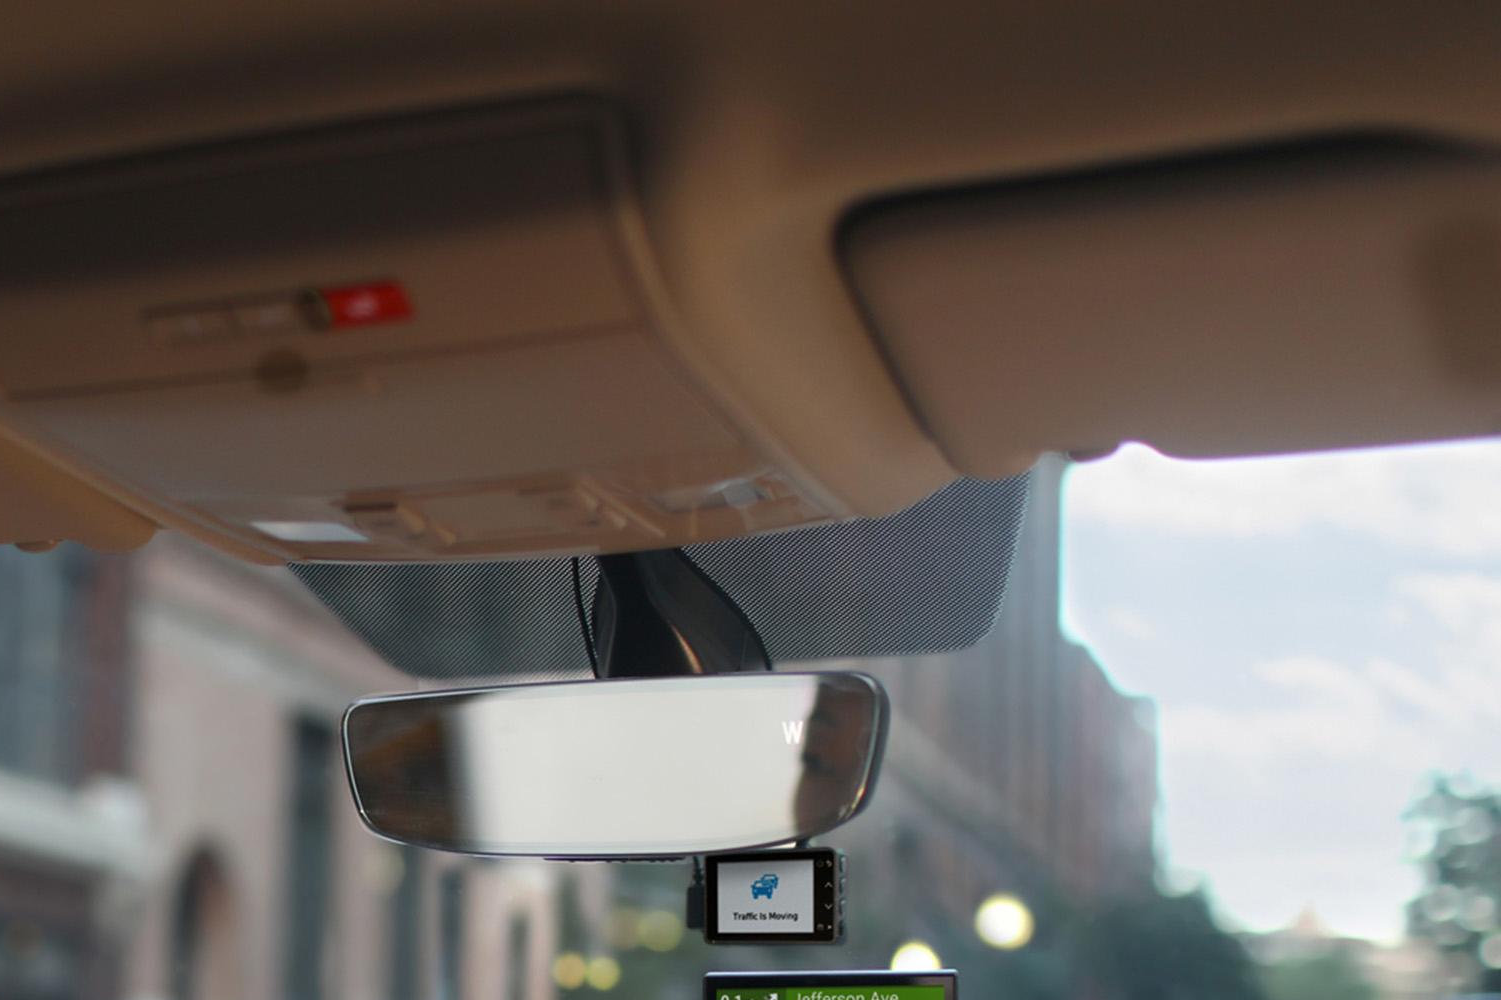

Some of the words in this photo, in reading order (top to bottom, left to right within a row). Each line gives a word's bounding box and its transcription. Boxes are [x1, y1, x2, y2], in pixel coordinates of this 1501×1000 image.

[781, 720, 803, 745] W
[733, 911, 758, 921] Traffic
[759, 911, 767, 921] Is
[768, 911, 799, 922] Moving
